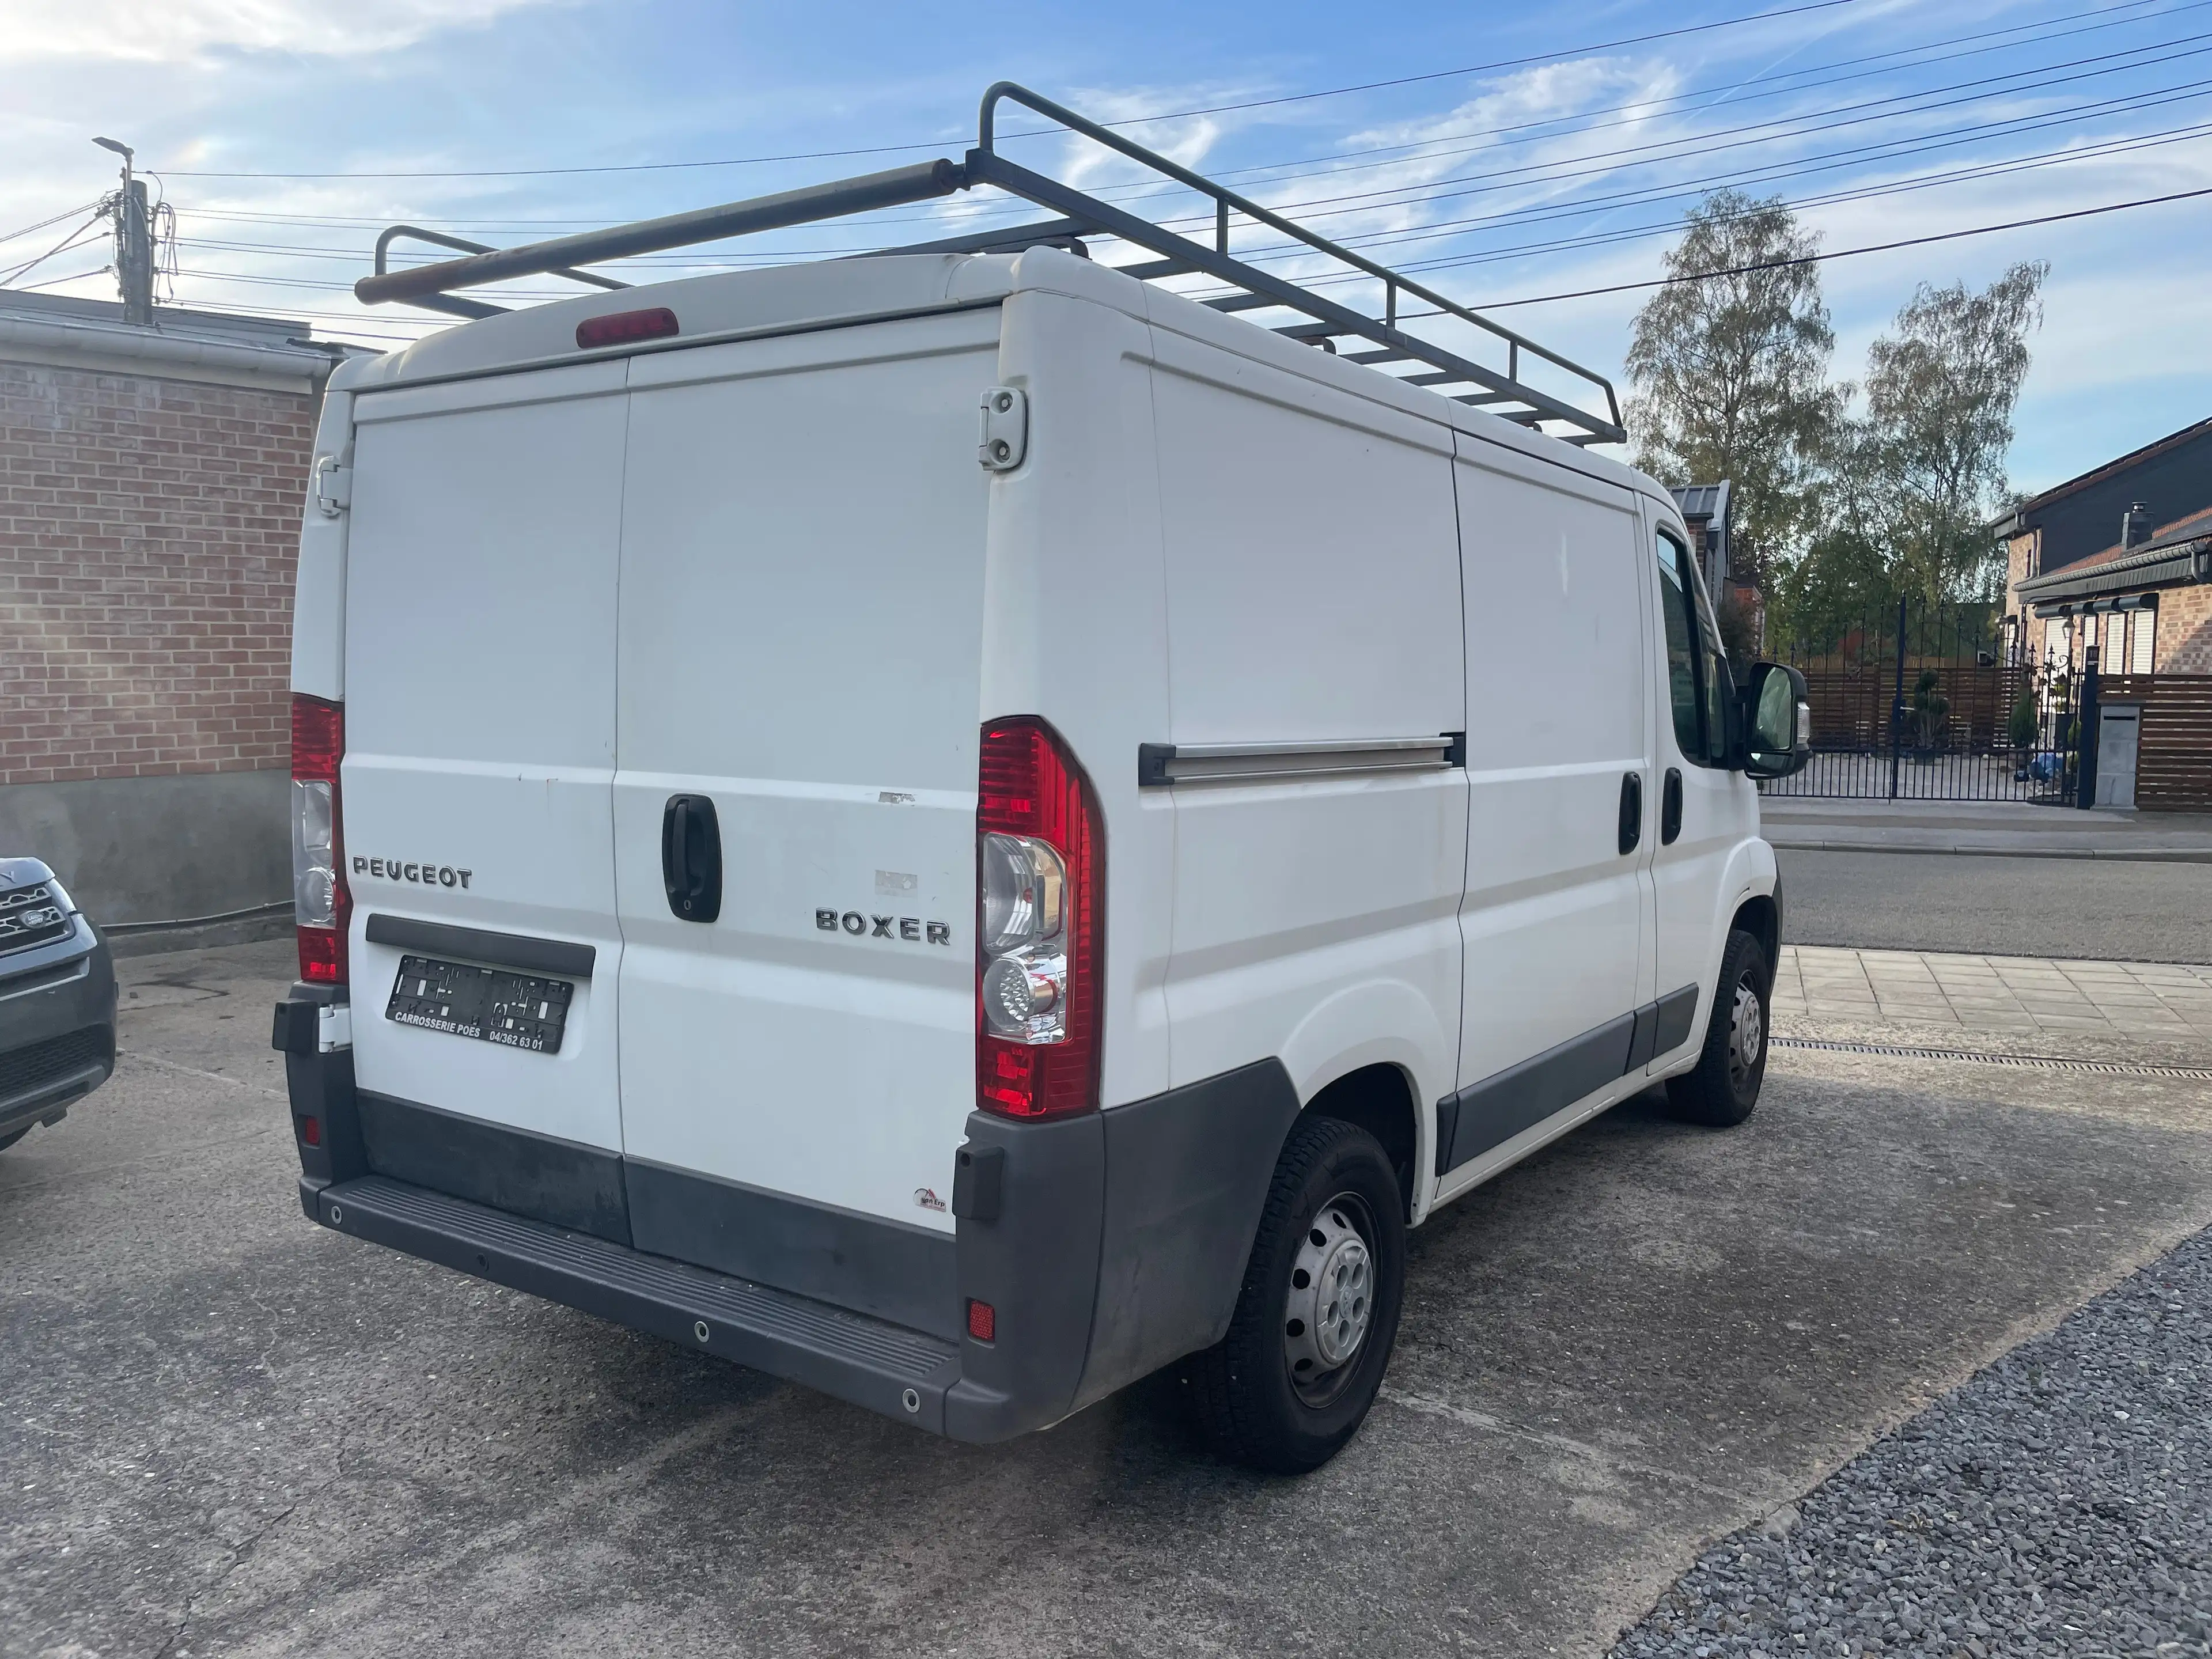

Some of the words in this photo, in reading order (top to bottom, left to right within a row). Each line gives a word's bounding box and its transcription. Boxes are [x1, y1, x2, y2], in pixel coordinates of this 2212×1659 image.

[353, 855, 472, 888] PEUGEOT
[816, 907, 950, 945] BOXER
[395, 1011, 455, 1032] CARROSSERIE
[457, 1024, 480, 1037] POES
[489, 1031, 517, 1045] 04/362
[519, 1037, 530, 1048] 63
[532, 1040, 543, 1051] 01
[934, 1199, 945, 1207] Erp
